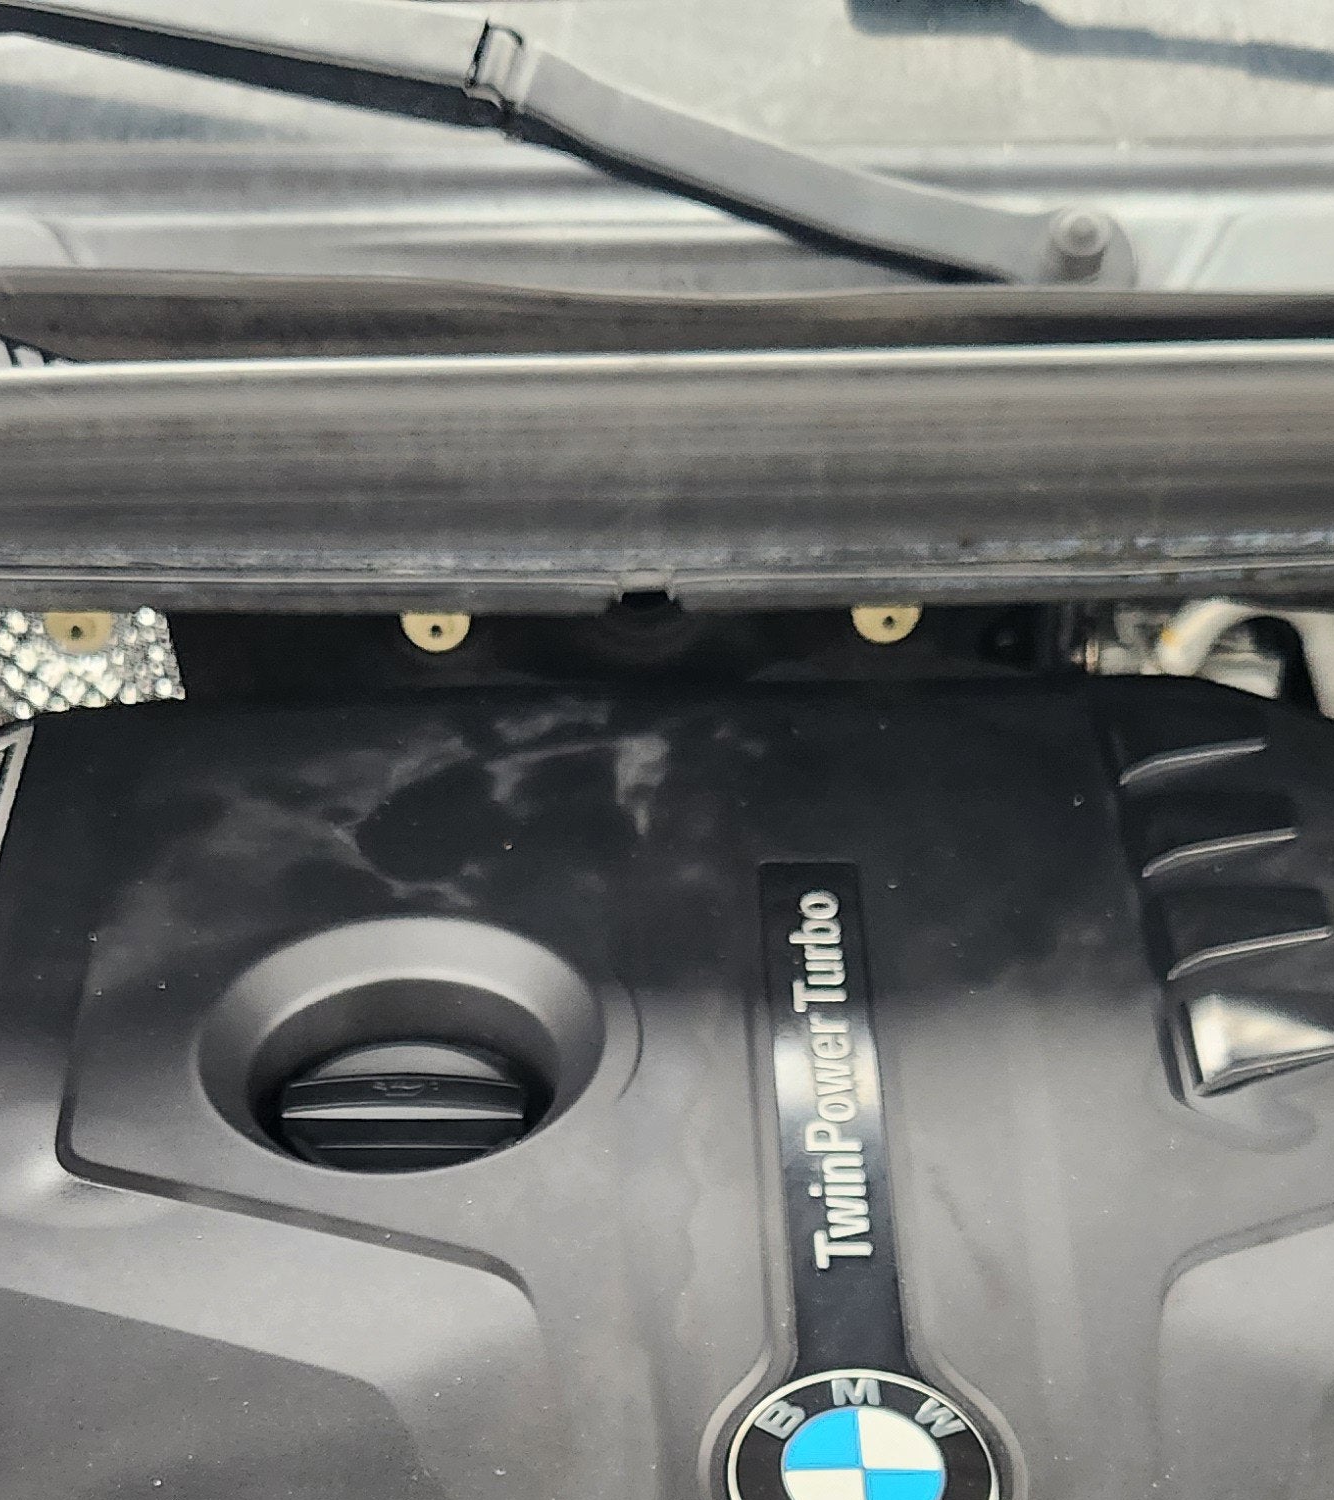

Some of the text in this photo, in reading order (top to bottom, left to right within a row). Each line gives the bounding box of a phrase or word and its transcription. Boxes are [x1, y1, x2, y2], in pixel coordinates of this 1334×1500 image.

[788, 888, 873, 1270] TwinPower Turbo
[754, 1377, 967, 1440] BMW
